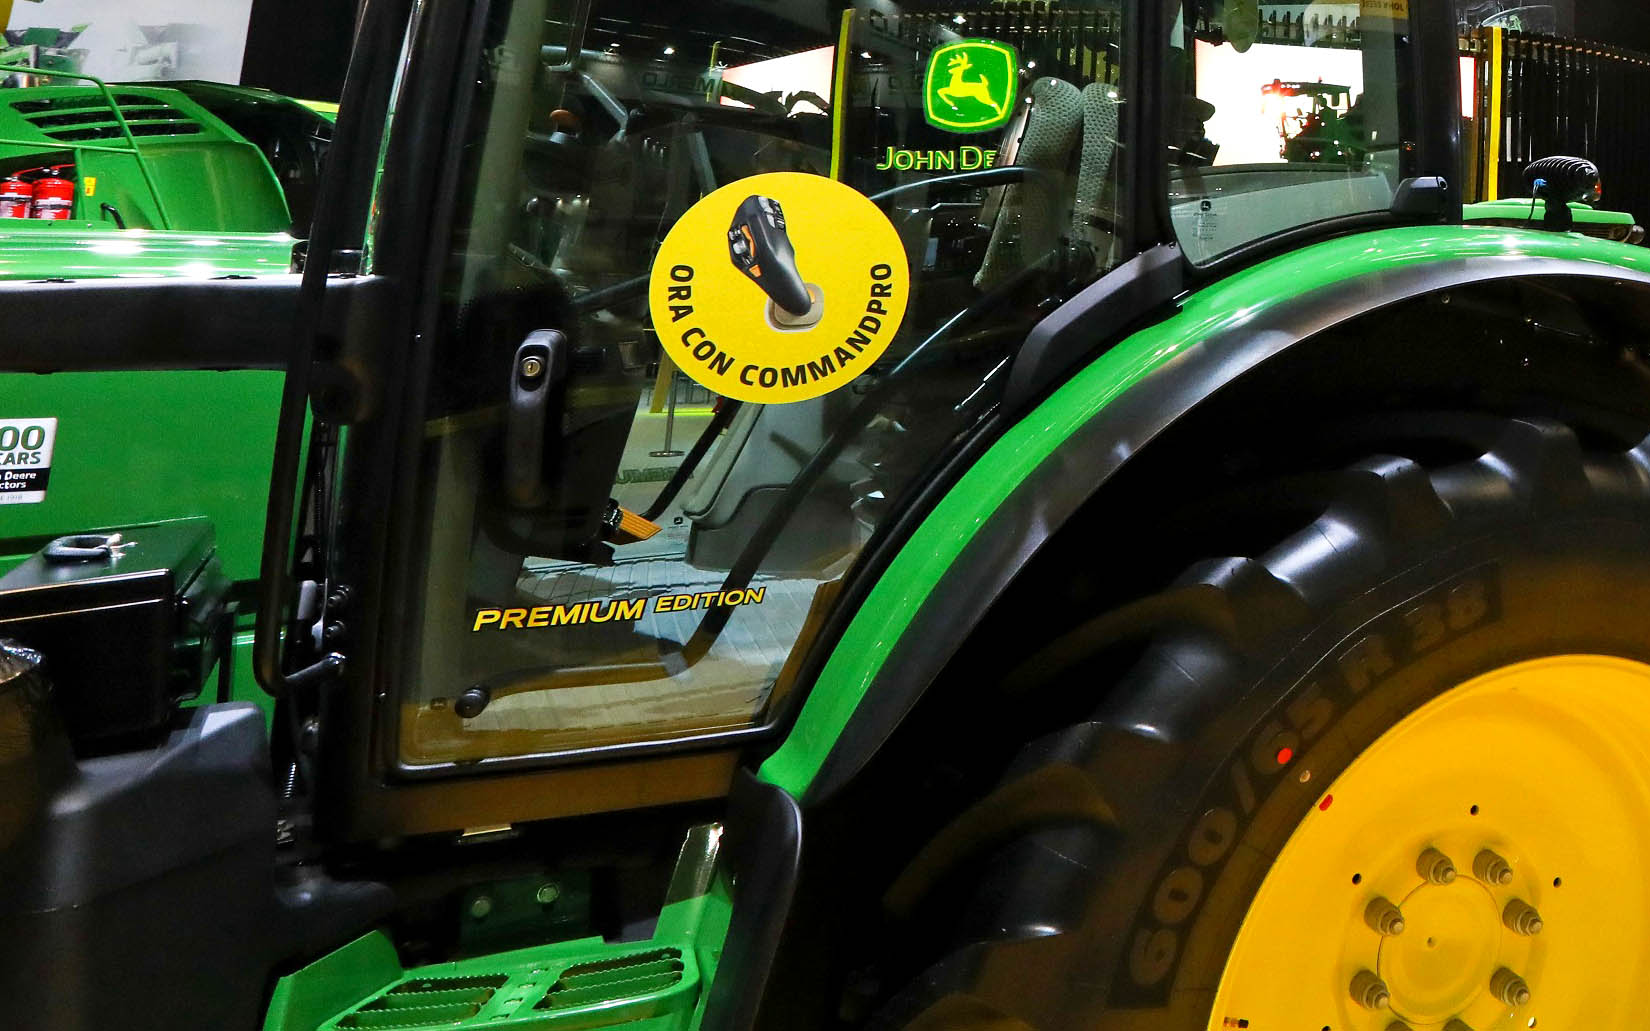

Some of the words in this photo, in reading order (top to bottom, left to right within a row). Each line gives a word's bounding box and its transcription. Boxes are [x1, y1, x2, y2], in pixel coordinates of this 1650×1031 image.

[876, 146, 954, 171] JOHN
[667, 264, 695, 323] ORA
[681, 327, 735, 377] CON
[740, 263, 893, 389] COMMANDPRO
[4, 471, 37, 481] Deere
[471, 598, 648, 633] PREMIUM
[653, 586, 767, 614] EDITION
